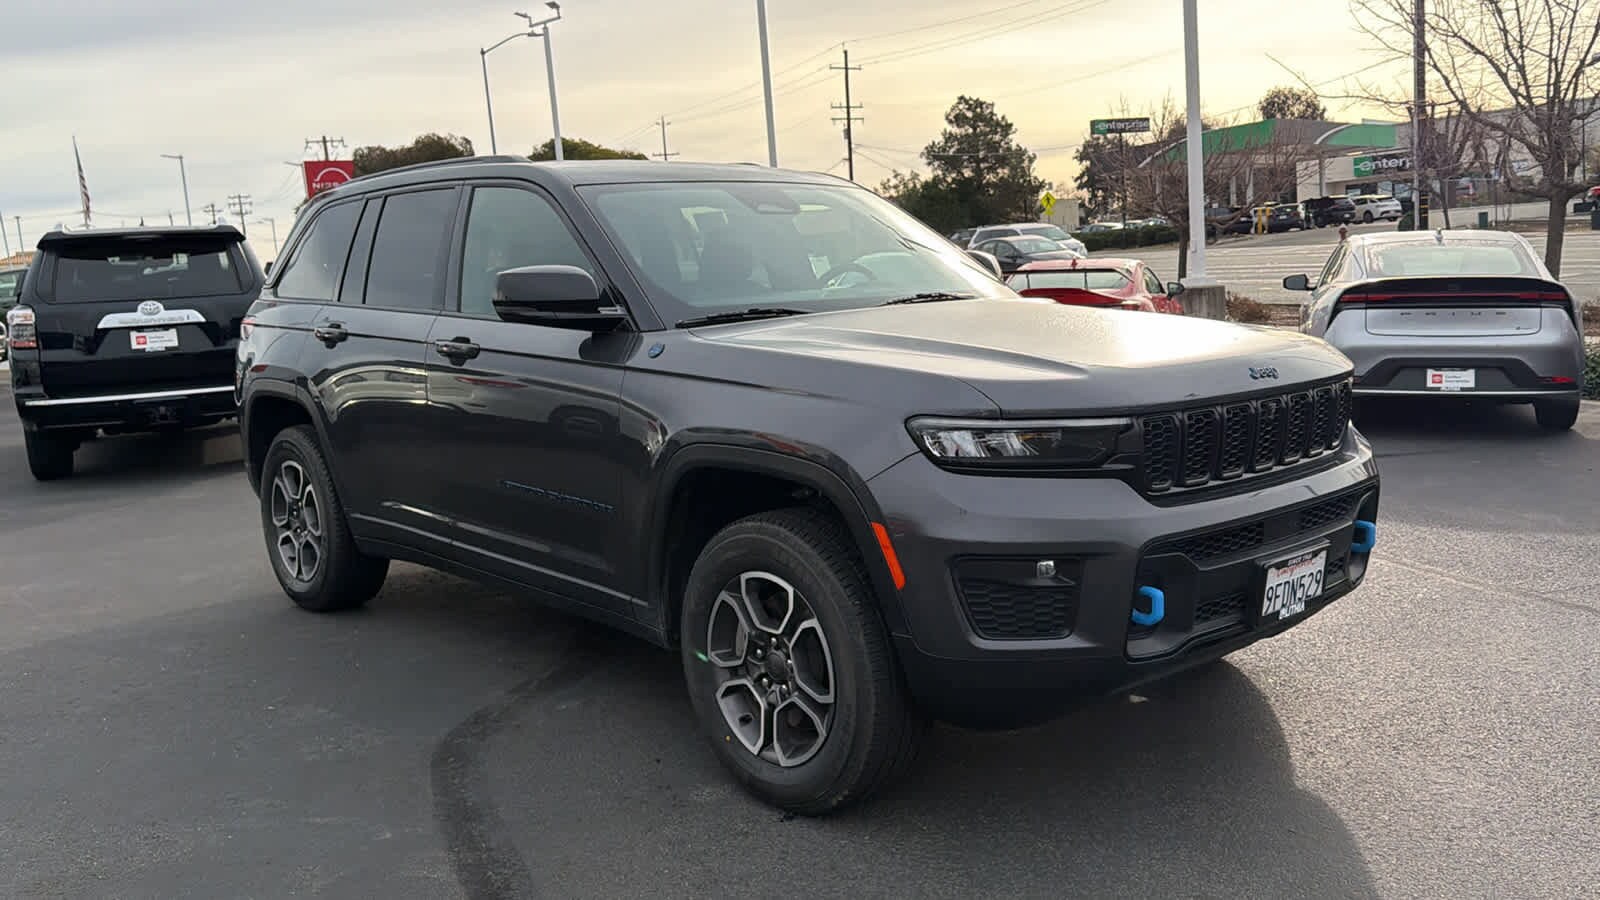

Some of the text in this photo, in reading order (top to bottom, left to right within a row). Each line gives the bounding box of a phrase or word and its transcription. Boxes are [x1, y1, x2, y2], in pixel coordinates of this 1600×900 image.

[1096, 120, 1149, 131] enterprise
[1248, 367, 1280, 380] Jeep
[1264, 569, 1323, 616] 9FDN529
